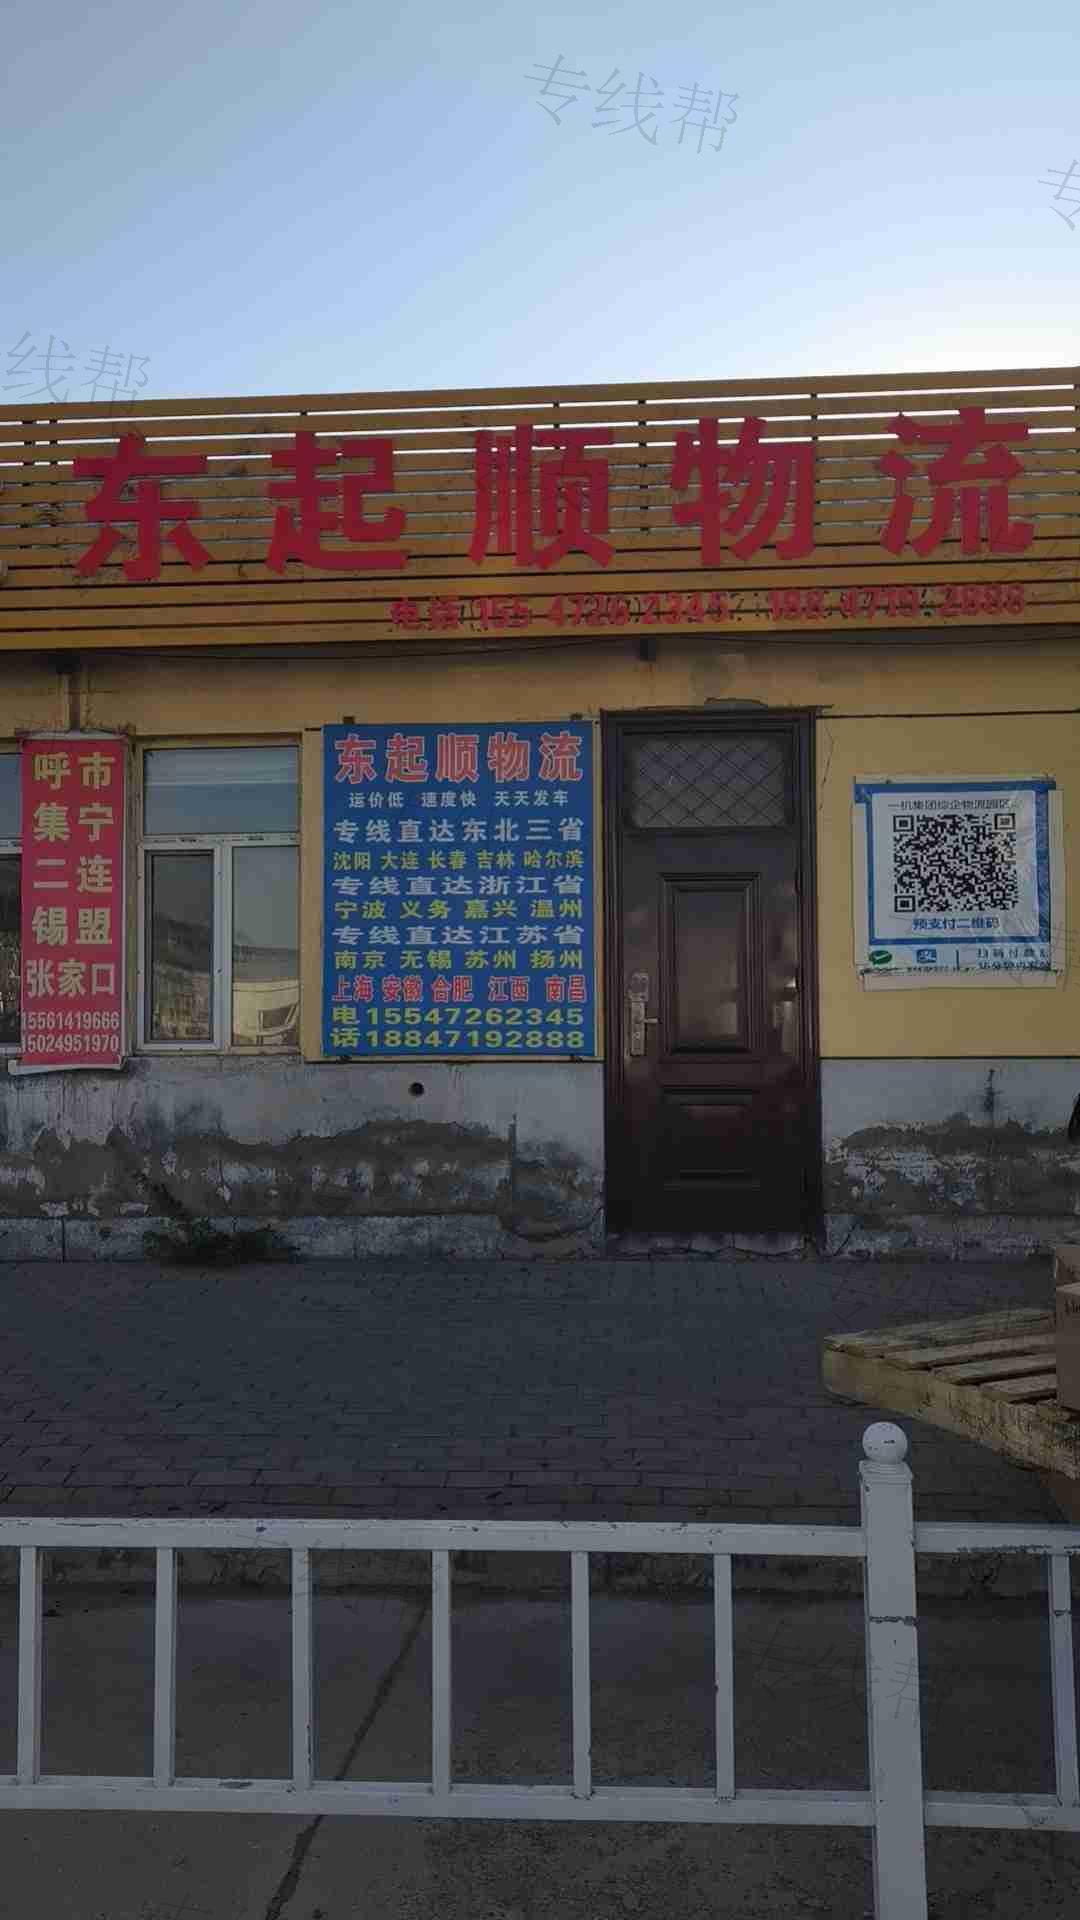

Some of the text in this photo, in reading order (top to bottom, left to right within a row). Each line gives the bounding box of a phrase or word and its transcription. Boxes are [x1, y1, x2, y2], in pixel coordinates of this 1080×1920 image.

[73, 408, 1036, 582] 东起顺物流
[334, 731, 584, 785] 东起顺物流
[32, 751, 116, 790] 呼市
[349, 789, 569, 808] 运价低 速度快 天天发车
[33, 802, 114, 842] 集宁
[333, 817, 585, 844] 专线直达东北三省
[333, 849, 585, 871] 沈阳 大连 长春 吉林 哈尔滨
[32, 854, 113, 893] 二连
[331, 875, 585, 896] 专线直达浙江省
[334, 899, 583, 920] 宁波 义务 嘉兴 温州
[31, 906, 113, 946] 锡盟
[331, 925, 585, 945] 专线直达江苏省
[333, 950, 583, 970] 南京 无锡 苏州 扬州
[25, 958, 116, 999] 张家口
[331, 974, 588, 1003] 上海 安徽 合肥 江西 南昌
[21, 1011, 120, 1031] 15561419666
[366, 1007, 585, 1026] 15547262345
[21, 1033, 120, 1054] 15024951970
[366, 1030, 585, 1049] 18847192888
